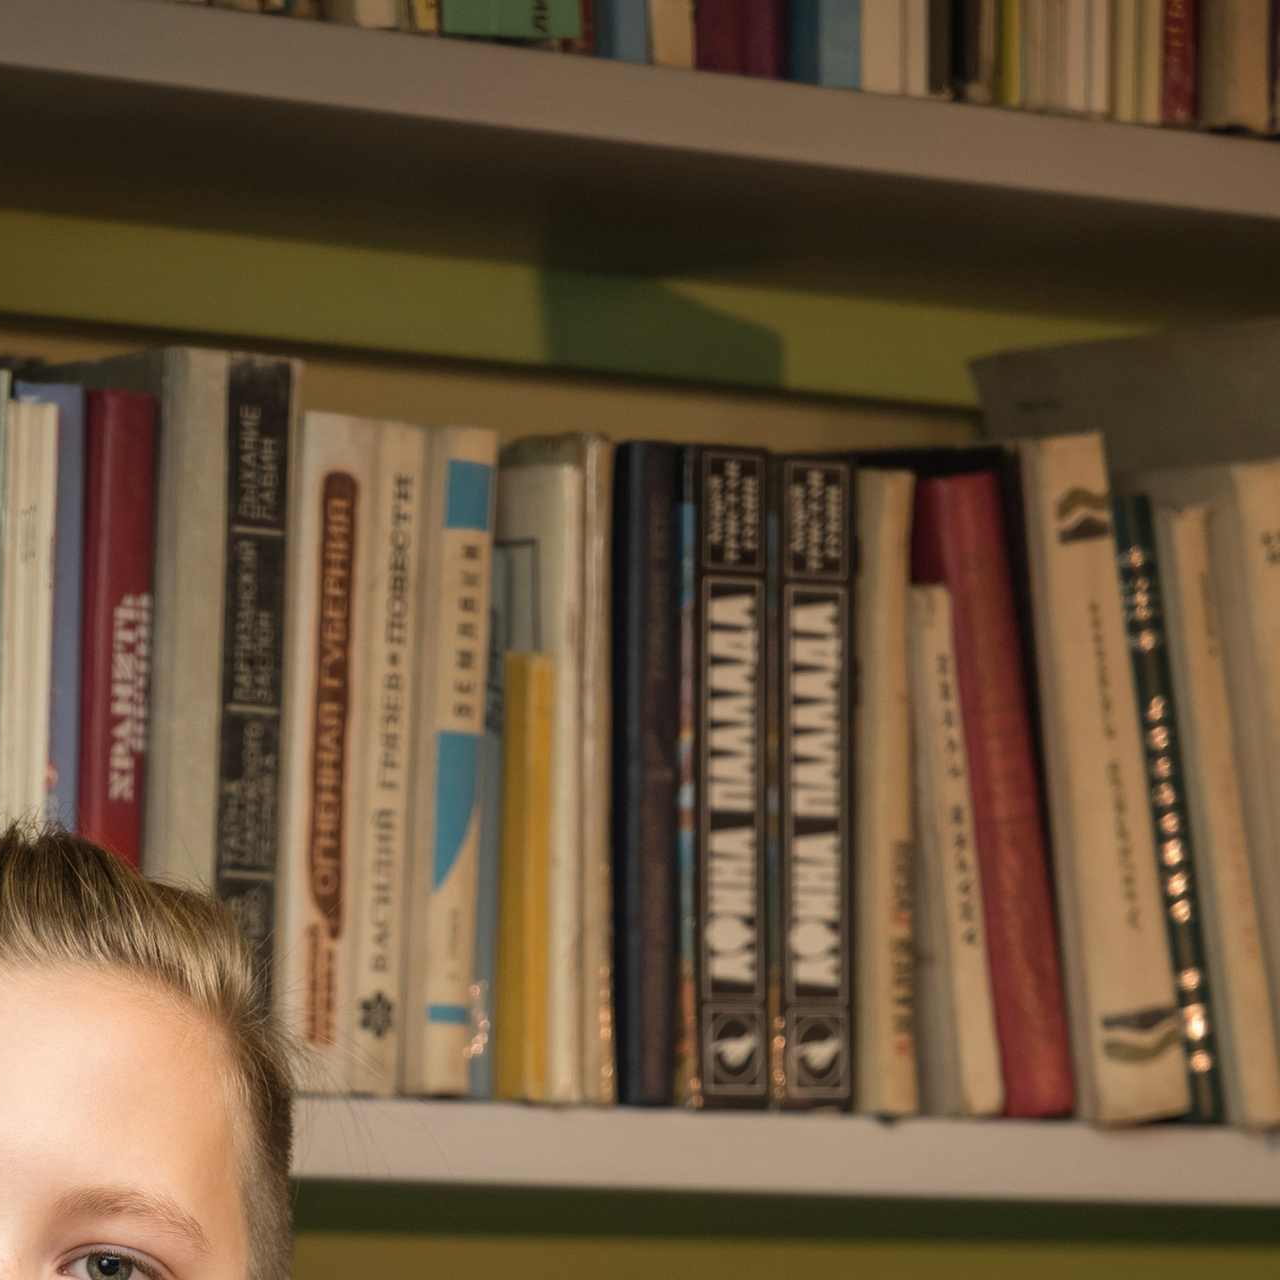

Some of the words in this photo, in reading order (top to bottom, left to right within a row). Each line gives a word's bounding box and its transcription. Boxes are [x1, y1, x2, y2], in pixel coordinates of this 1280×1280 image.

[319, 499, 350, 686] ГУБЕРНИЯ
[707, 596, 757, 810] ПАЛЛАДА
[790, 604, 840, 816] ПАЛЛАДА
[368, 808, 399, 975] ВАСИЛИЙ
